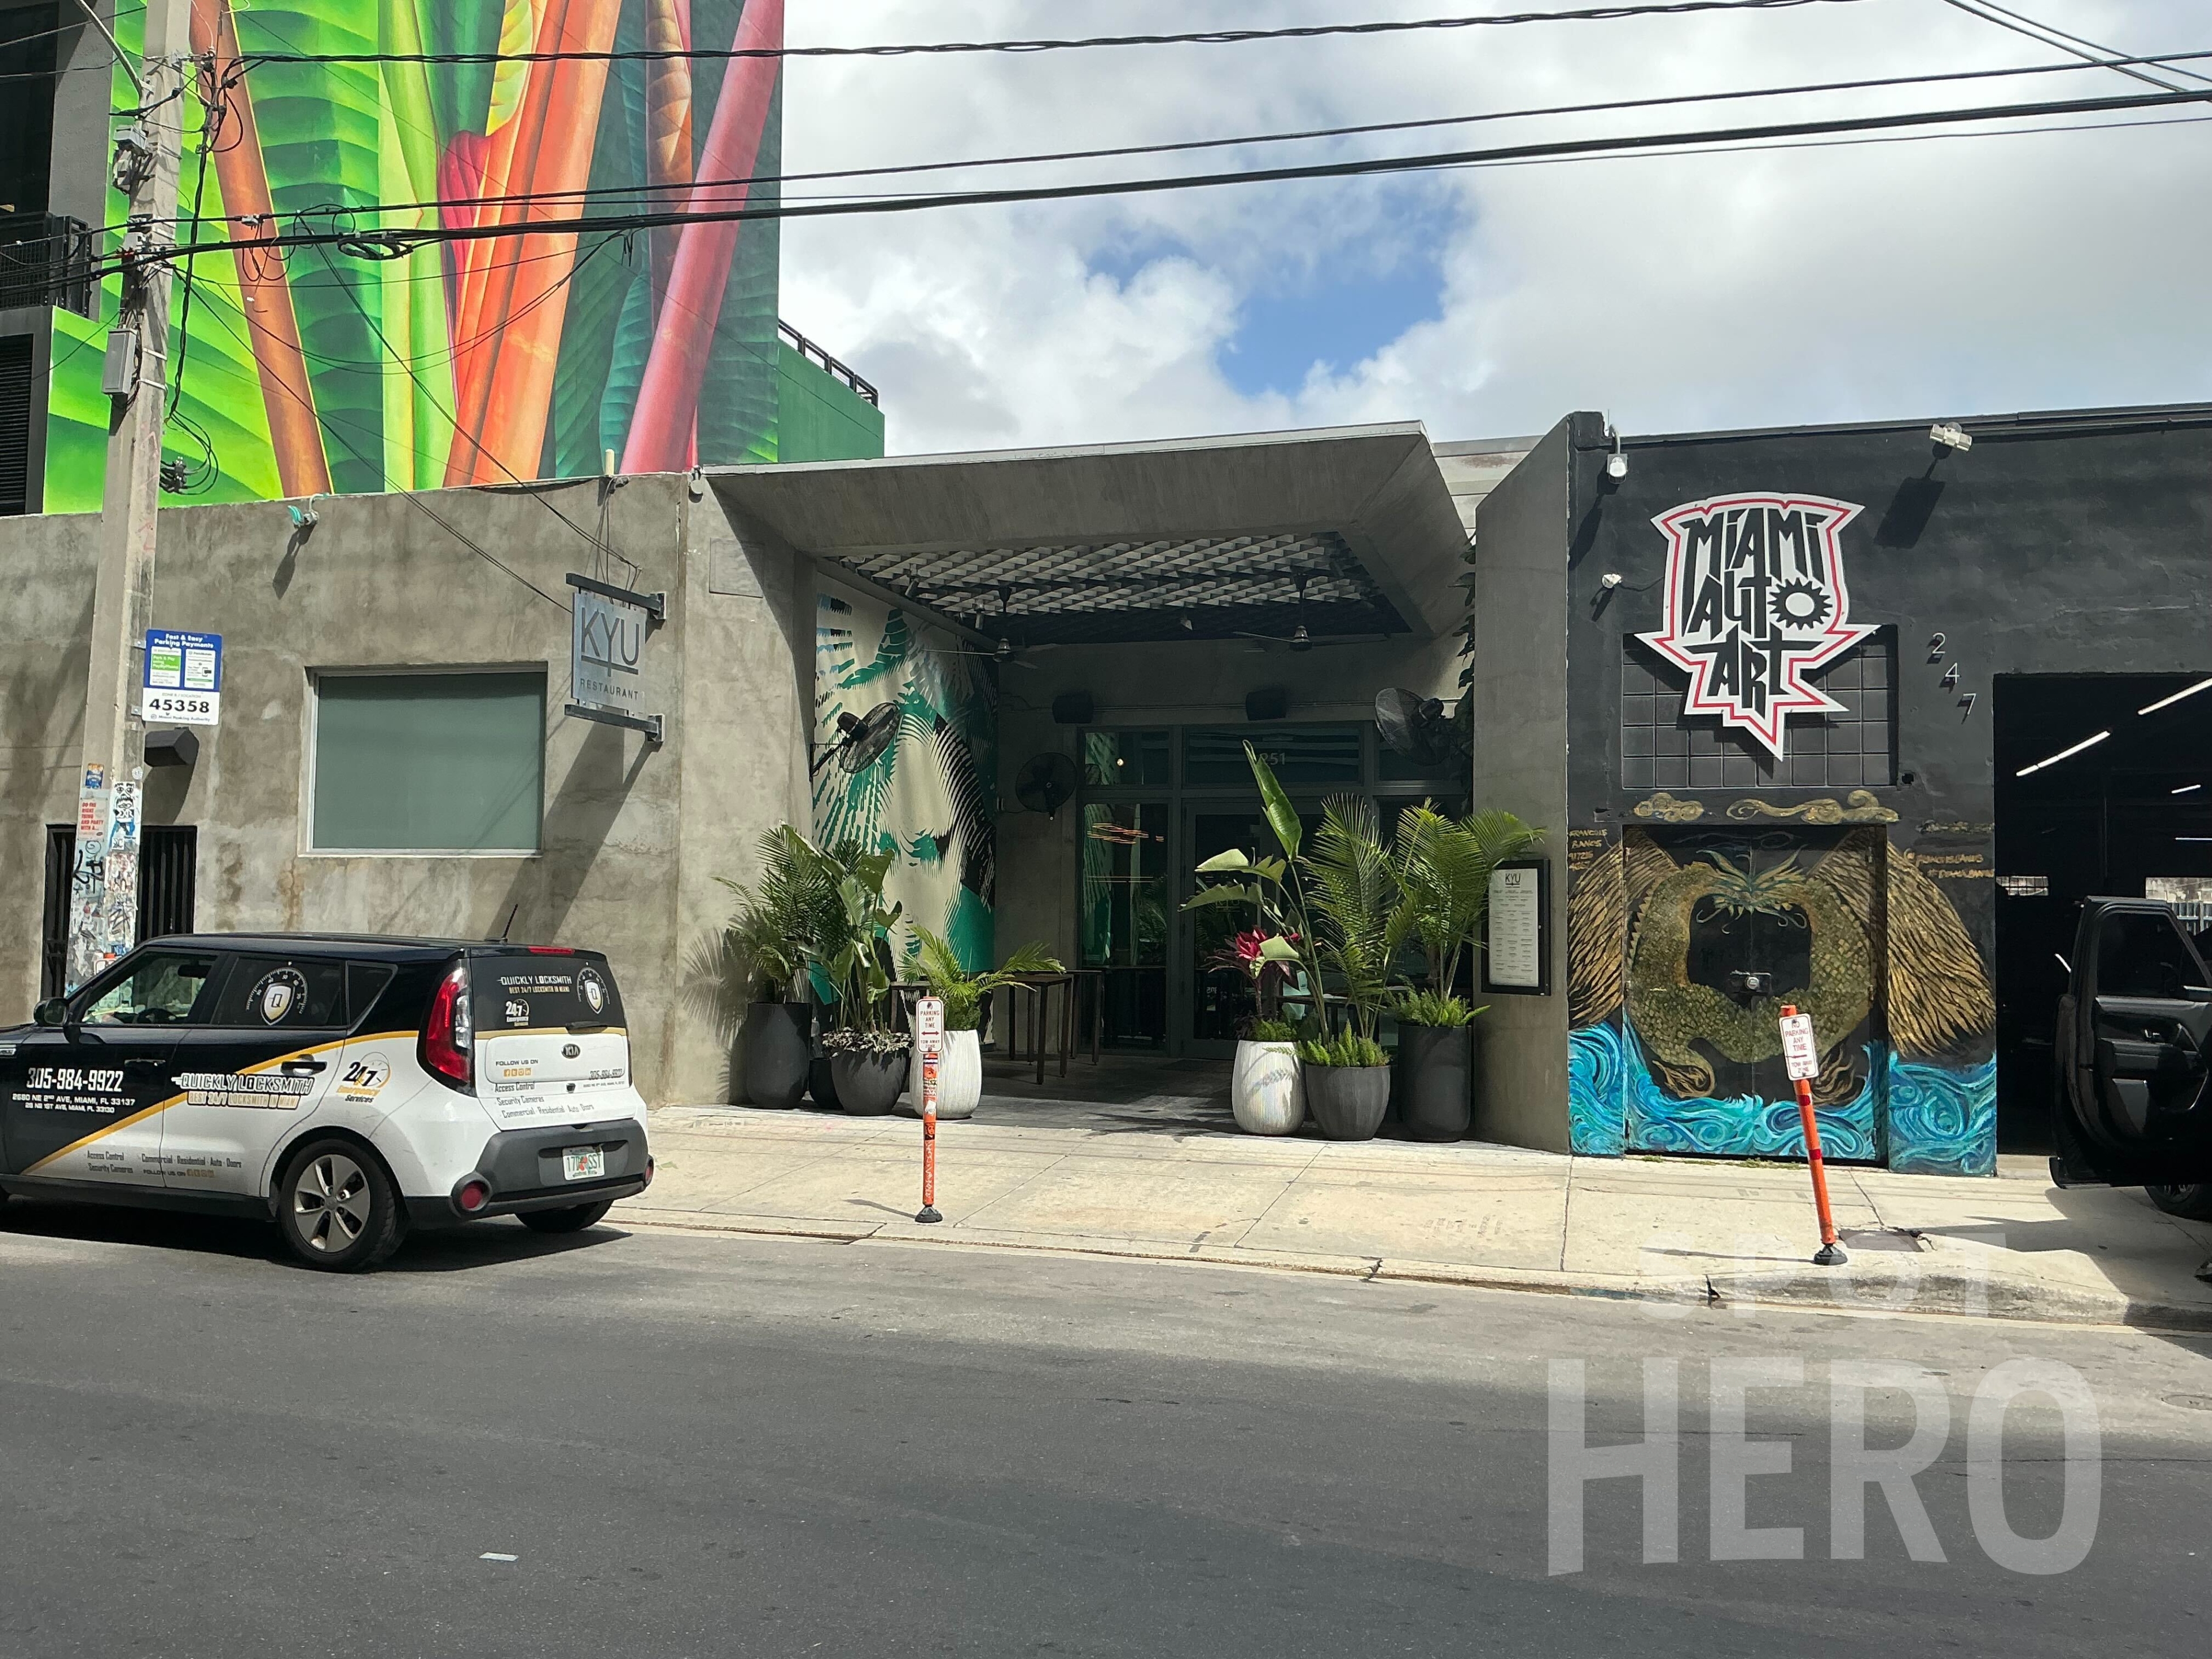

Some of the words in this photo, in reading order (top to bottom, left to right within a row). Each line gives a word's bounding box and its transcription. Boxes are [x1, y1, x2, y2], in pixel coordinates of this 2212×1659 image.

[1679, 507, 1829, 637] MIAMI
[1686, 570, 1833, 641] AUTO
[154, 638, 180, 646] Parking
[182, 640, 214, 649] Payments
[581, 607, 639, 677] KYU
[1682, 622, 1825, 719] ART
[580, 678, 638, 700] RESTAURANT
[149, 698, 209, 713] 45358
[1505, 873, 1521, 885] KYU
[501, 975, 533, 986] QUICKLY
[535, 975, 573, 984] LOCKSMITH
[1785, 1028, 1809, 1037] PARKING
[26, 1067, 124, 1092] 305-984-9922
[180, 1072, 237, 1092] QUICKLY
[237, 1074, 315, 1094] LOCKSMITH
[495, 1083, 514, 1093] Access
[516, 1081, 535, 1090] Control
[56, 1096, 72, 1104] AVE,
[74, 1096, 98, 1105] MIAMI,
[111, 1098, 135, 1106] 33137
[189, 1092, 207, 1104] BEST
[208, 1092, 228, 1105] 24/7
[229, 1093, 269, 1107] LOCKSMITH
[497, 1096, 521, 1106] Security
[520, 1096, 544, 1104] Cameras
[501, 1107, 535, 1118] Commercial
[88, 1150, 104, 1160] Access
